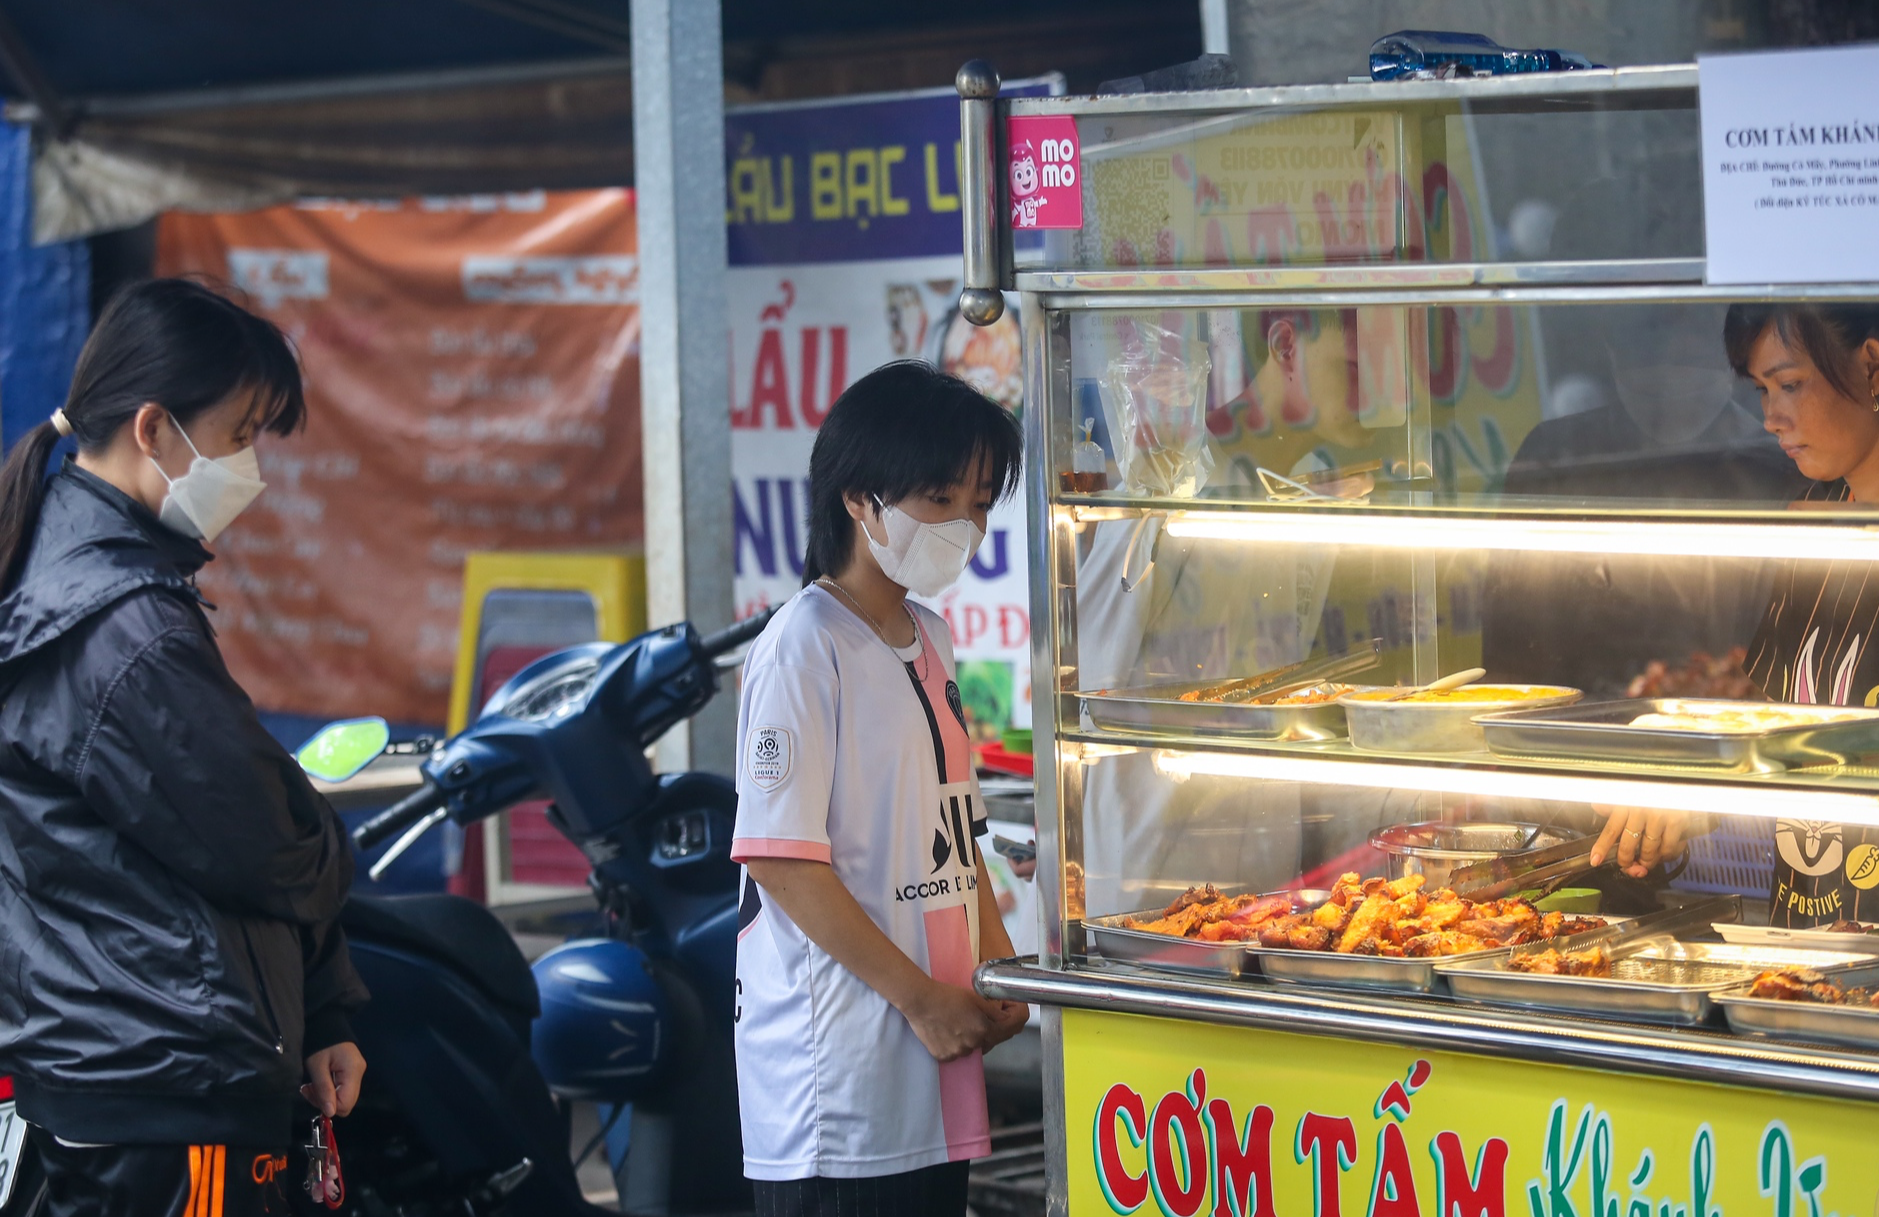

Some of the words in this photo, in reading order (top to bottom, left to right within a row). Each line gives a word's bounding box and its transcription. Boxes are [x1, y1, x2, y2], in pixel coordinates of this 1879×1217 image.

[1725, 128, 1767, 148] CƠM
[812, 146, 910, 230] BẠC
[1787, 888, 1842, 917] POSTIVE
[1093, 1067, 1276, 1217] CƠM
[1294, 1058, 1510, 1217] TẤM
